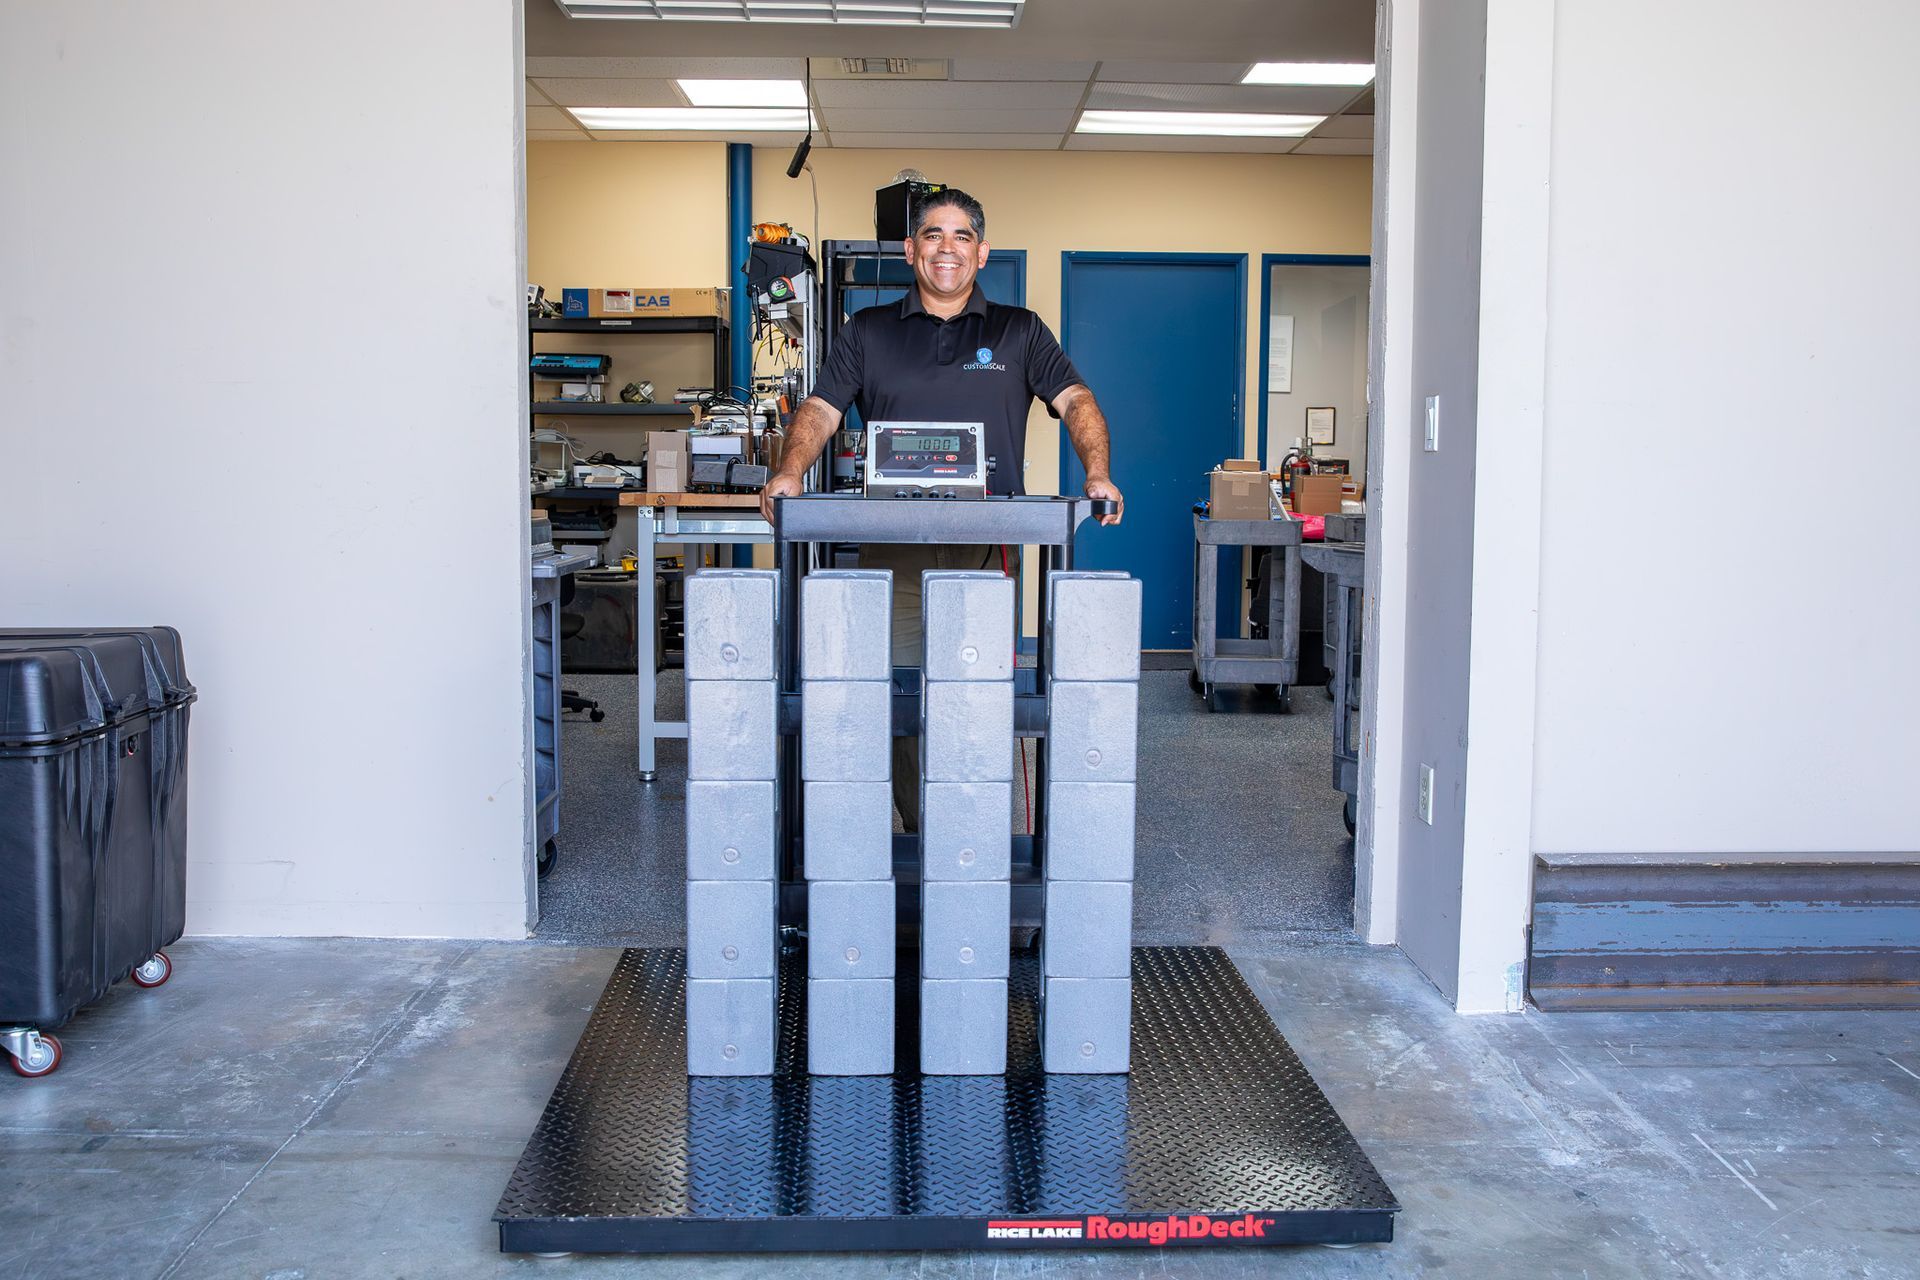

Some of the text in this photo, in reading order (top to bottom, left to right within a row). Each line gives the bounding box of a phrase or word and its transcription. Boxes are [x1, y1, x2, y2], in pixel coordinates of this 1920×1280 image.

[635, 295, 670, 307] CAS
[963, 363, 1006, 371] CUSTOMSCALE
[918, 439, 951, 450] 1000
[987, 1227, 1030, 1238] RICE
[1031, 1227, 1083, 1238] LAKE
